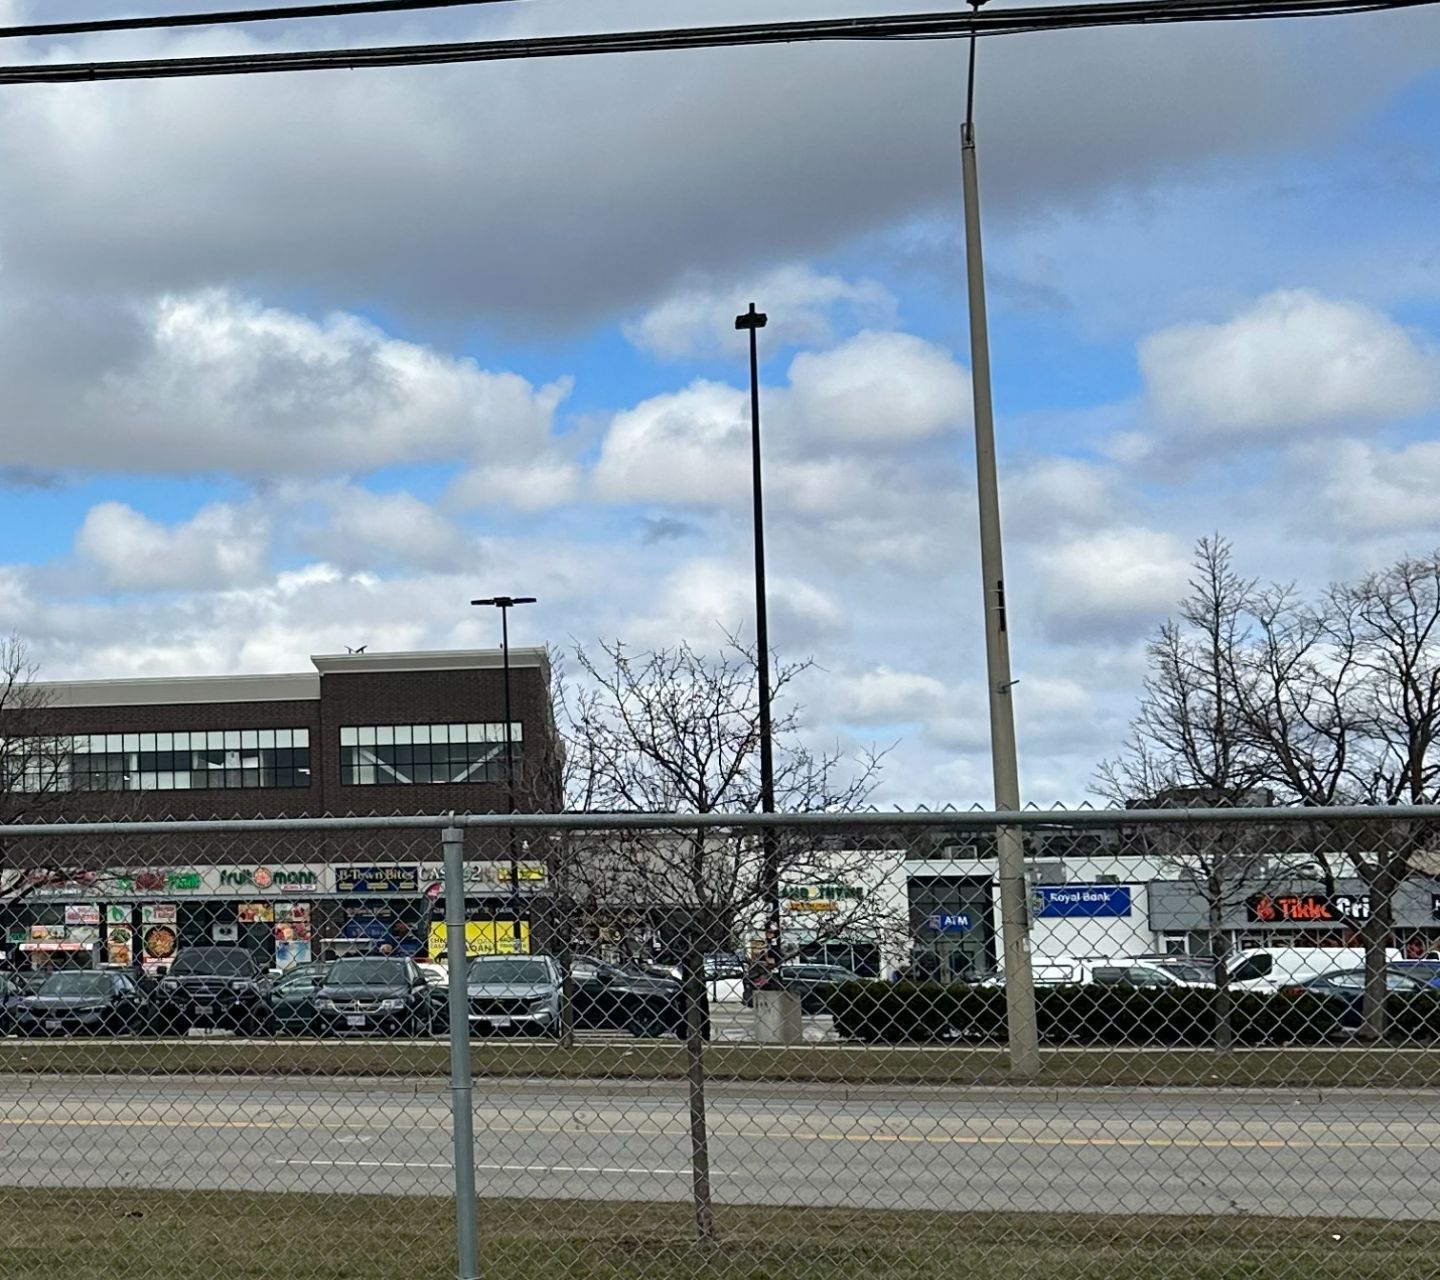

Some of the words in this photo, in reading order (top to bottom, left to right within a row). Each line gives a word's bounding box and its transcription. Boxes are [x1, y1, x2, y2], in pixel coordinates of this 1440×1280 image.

[384, 868, 415, 880] Bites
[1049, 892, 1080, 904] Royal
[1082, 892, 1111, 902] Bank
[1335, 897, 1370, 918] Gri
[943, 915, 969, 926] ATM
